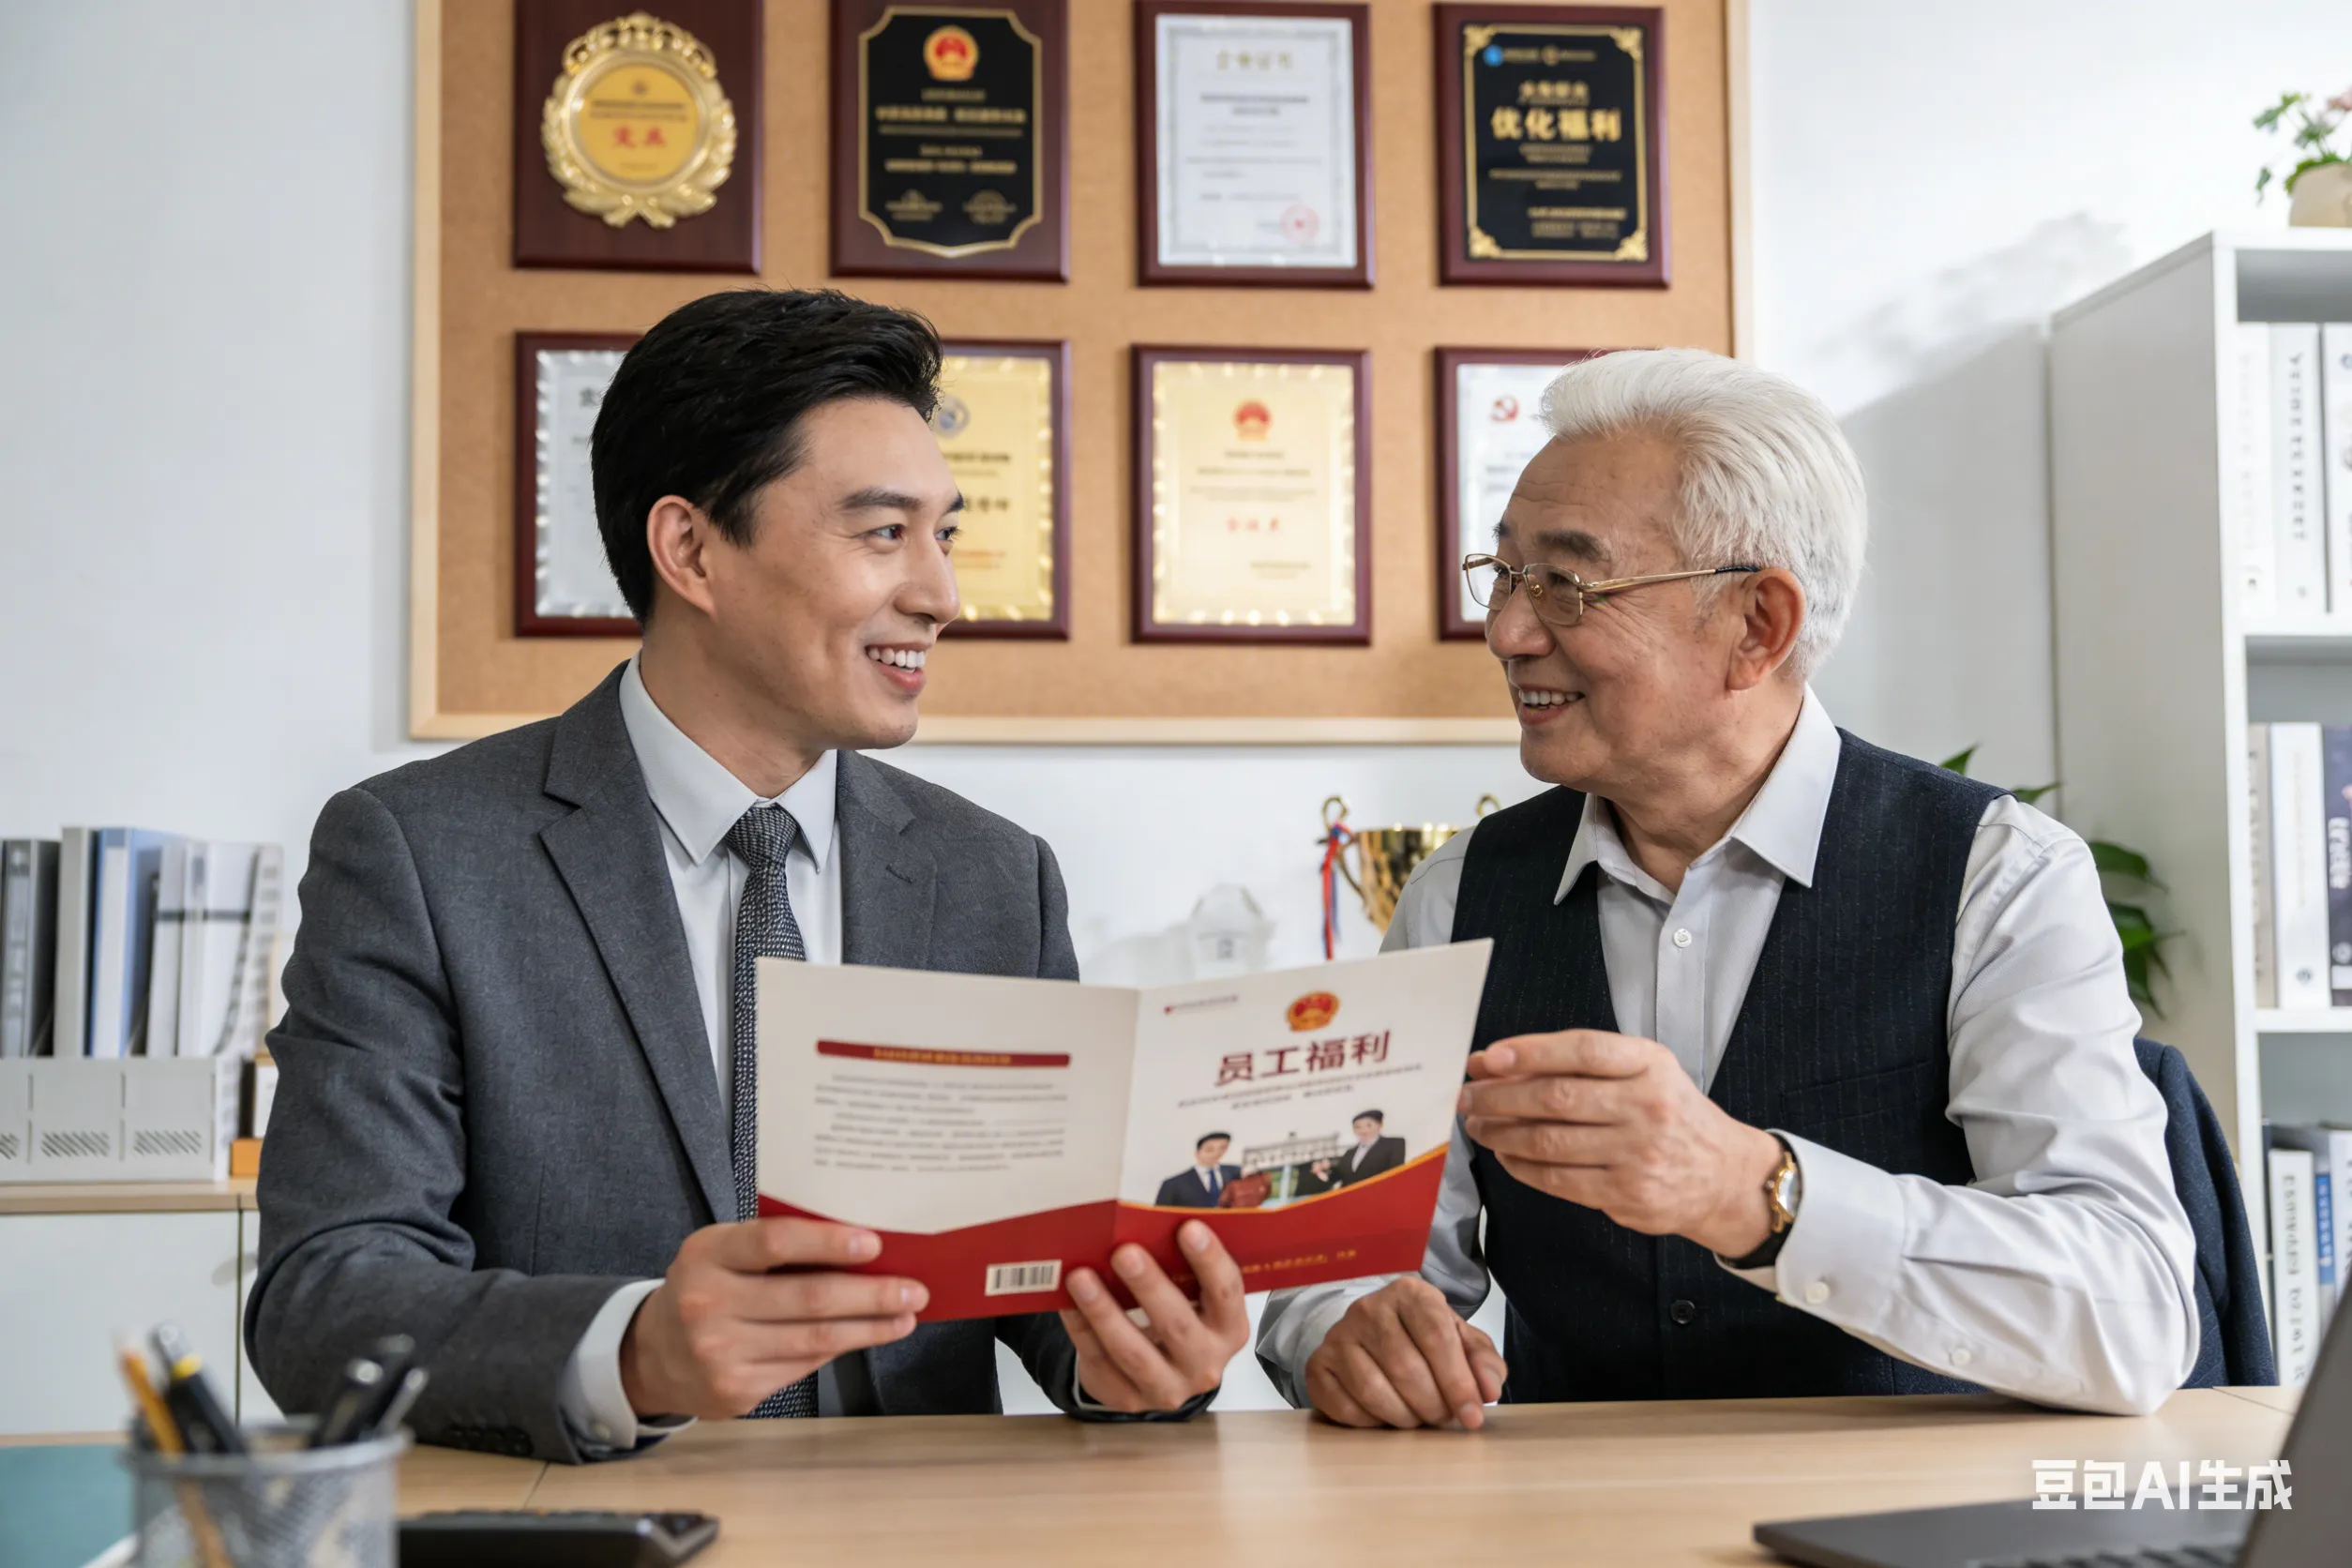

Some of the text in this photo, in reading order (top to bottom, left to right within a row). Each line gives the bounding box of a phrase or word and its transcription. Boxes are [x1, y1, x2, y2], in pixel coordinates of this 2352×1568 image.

[1491, 106, 1622, 142] 优化福利
[1215, 1030, 1391, 1087] 员工福利
